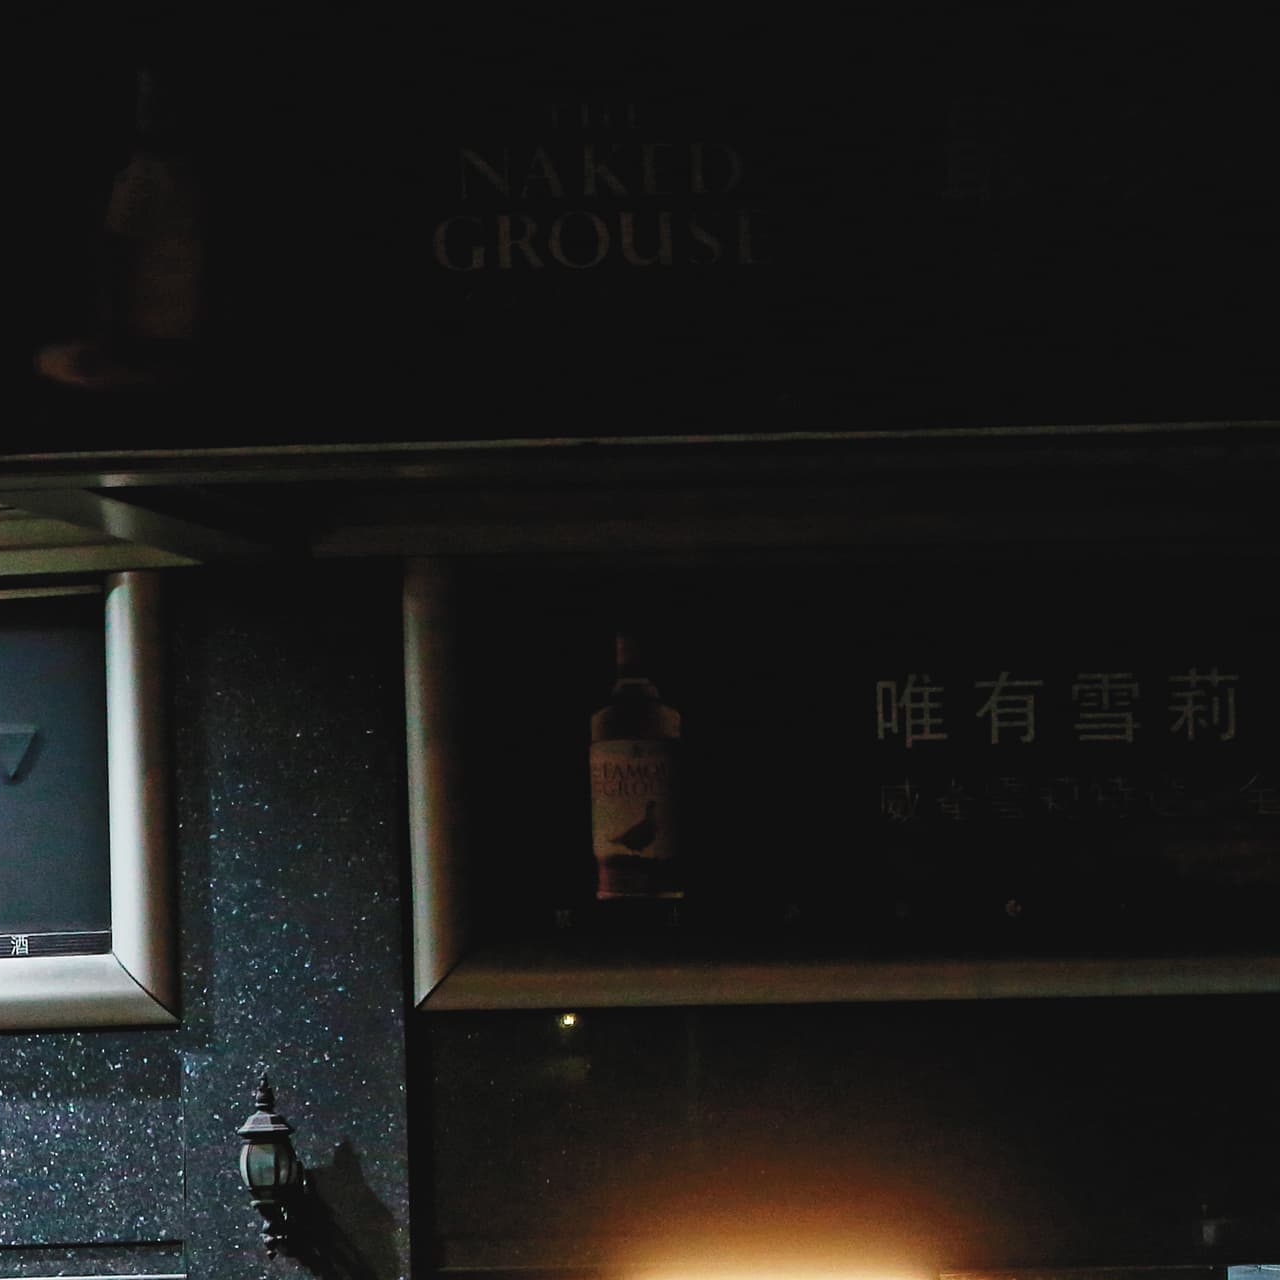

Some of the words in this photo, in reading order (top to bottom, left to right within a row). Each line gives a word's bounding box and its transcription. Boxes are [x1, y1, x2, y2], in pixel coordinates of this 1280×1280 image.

[457, 141, 745, 199] NAKED
[432, 208, 774, 272] GROUSE
[874, 667, 1240, 749] 唯有雪莉
